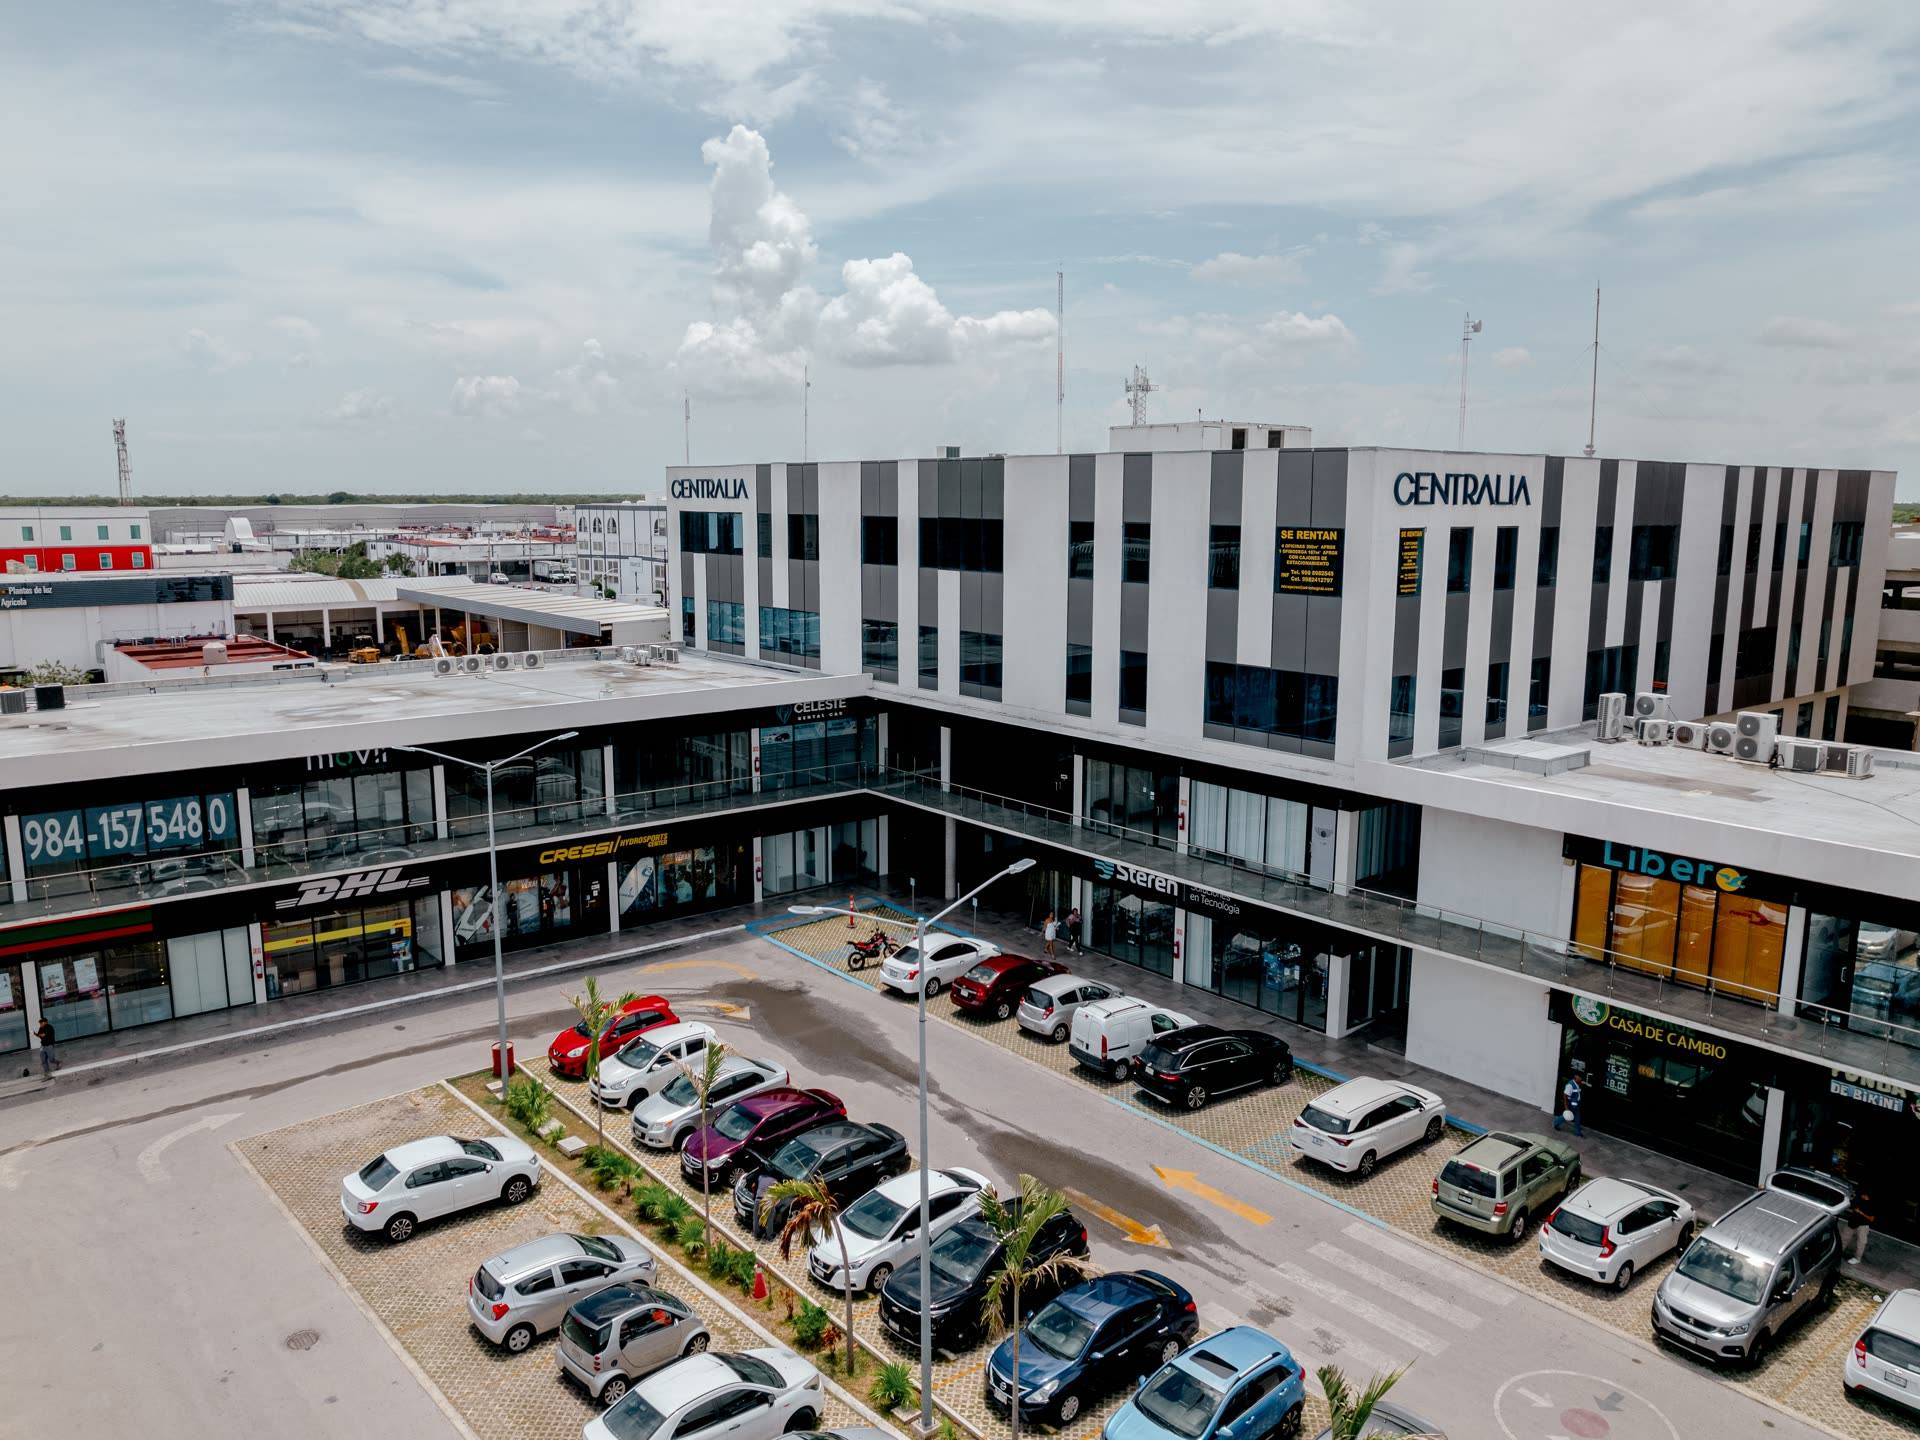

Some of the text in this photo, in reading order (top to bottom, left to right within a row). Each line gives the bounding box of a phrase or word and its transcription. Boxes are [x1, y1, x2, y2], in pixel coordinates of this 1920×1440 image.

[671, 478, 748, 499] CENTRALIA
[1393, 472, 1531, 506] CENTRALIA
[1281, 530, 1337, 540] SE RENTAN
[8, 585, 53, 595] Plantas de luz
[793, 700, 847, 713] CELESTE
[24, 797, 227, 861] 984-157-5480
[620, 833, 669, 847] HYDROSPORTS
[647, 840, 668, 848] CENTER
[540, 841, 614, 865] CRESSI
[297, 867, 410, 907] DHL
[1115, 863, 1179, 897] Steren
[1609, 1015, 1727, 1060] CASA DE CAMBIO
[1830, 1082, 1850, 1096] DE
